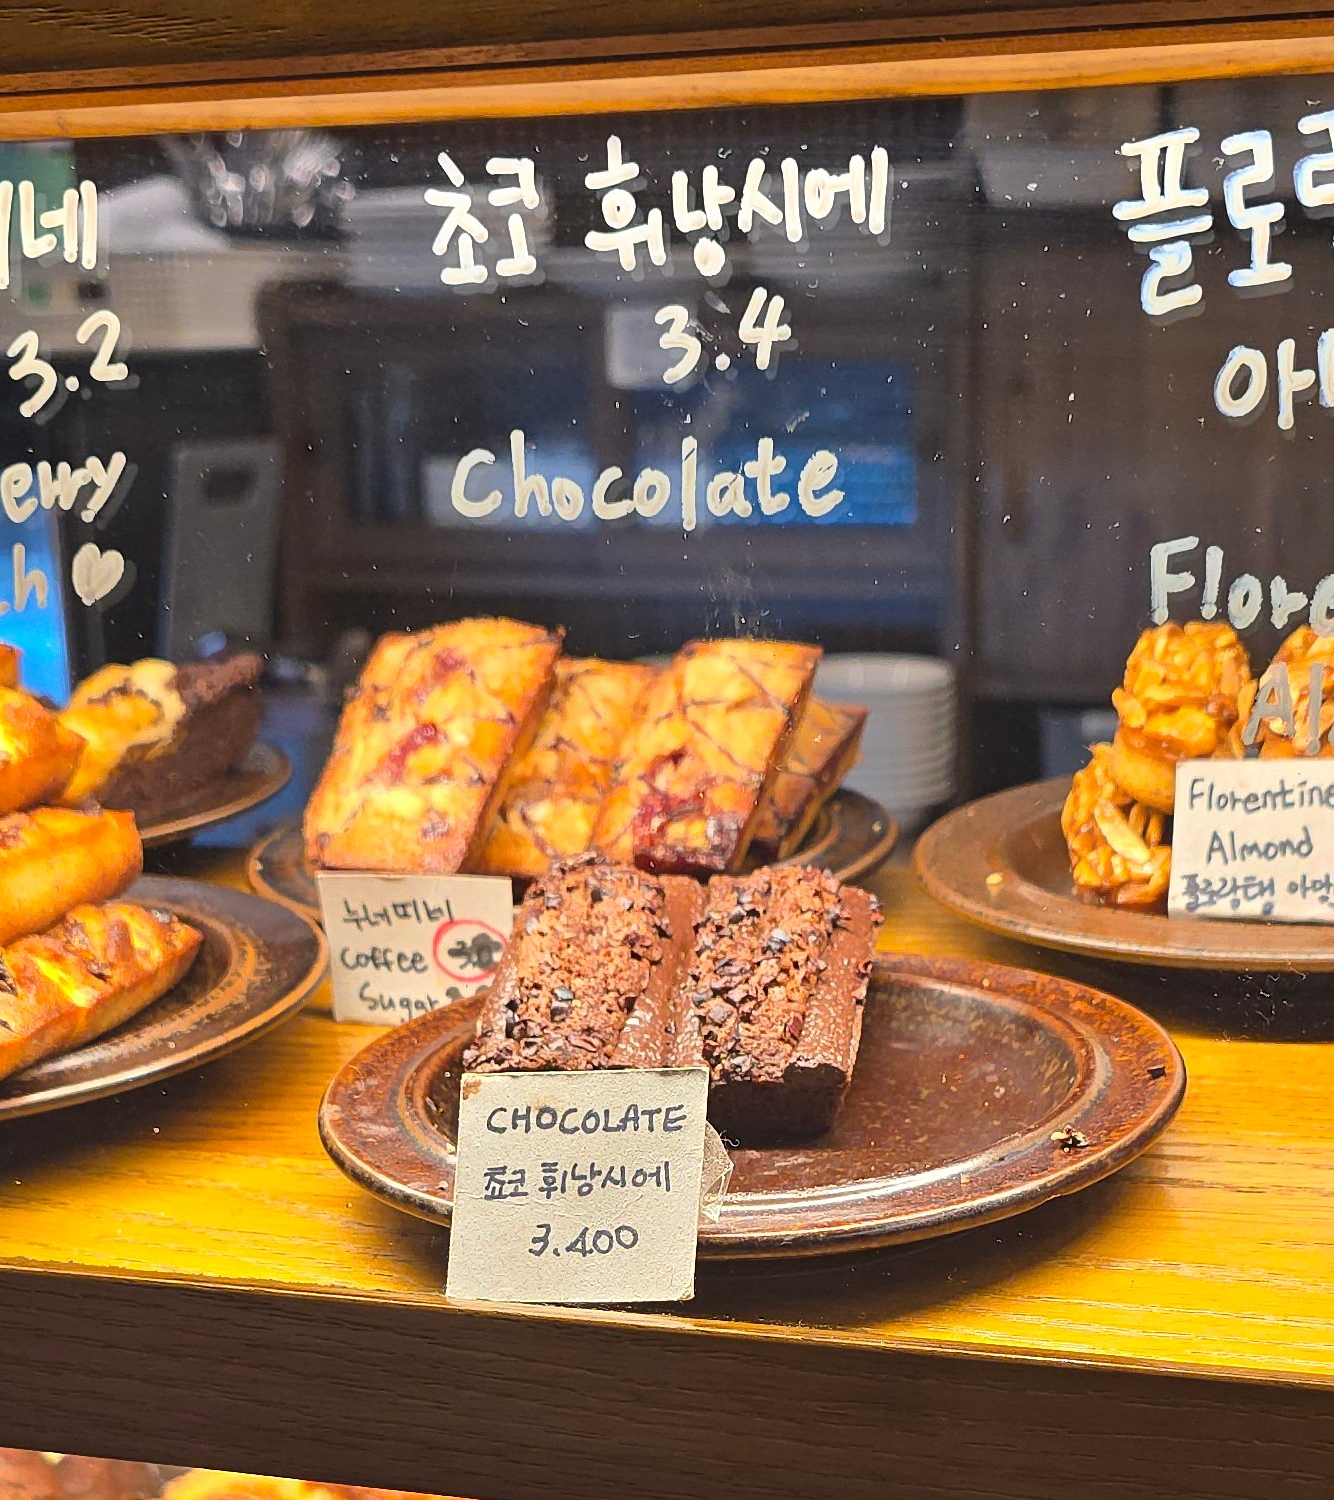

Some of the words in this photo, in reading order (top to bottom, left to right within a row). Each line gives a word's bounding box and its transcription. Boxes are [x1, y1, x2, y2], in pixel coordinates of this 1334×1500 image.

[423, 152, 540, 285] 초코
[584, 135, 889, 277] 휘낭시에
[654, 286, 791, 384] 3.4
[6, 310, 128, 418] 3.2
[451, 428, 846, 532] Chocolate
[1206, 825, 1314, 865] Almond
[340, 945, 428, 973] Coffee
[359, 981, 442, 1021] Sugar
[486, 1103, 687, 1134] CHOCOLATE
[538, 1160, 671, 1199] 휘낭시에
[528, 1223, 639, 1257] 3.400
